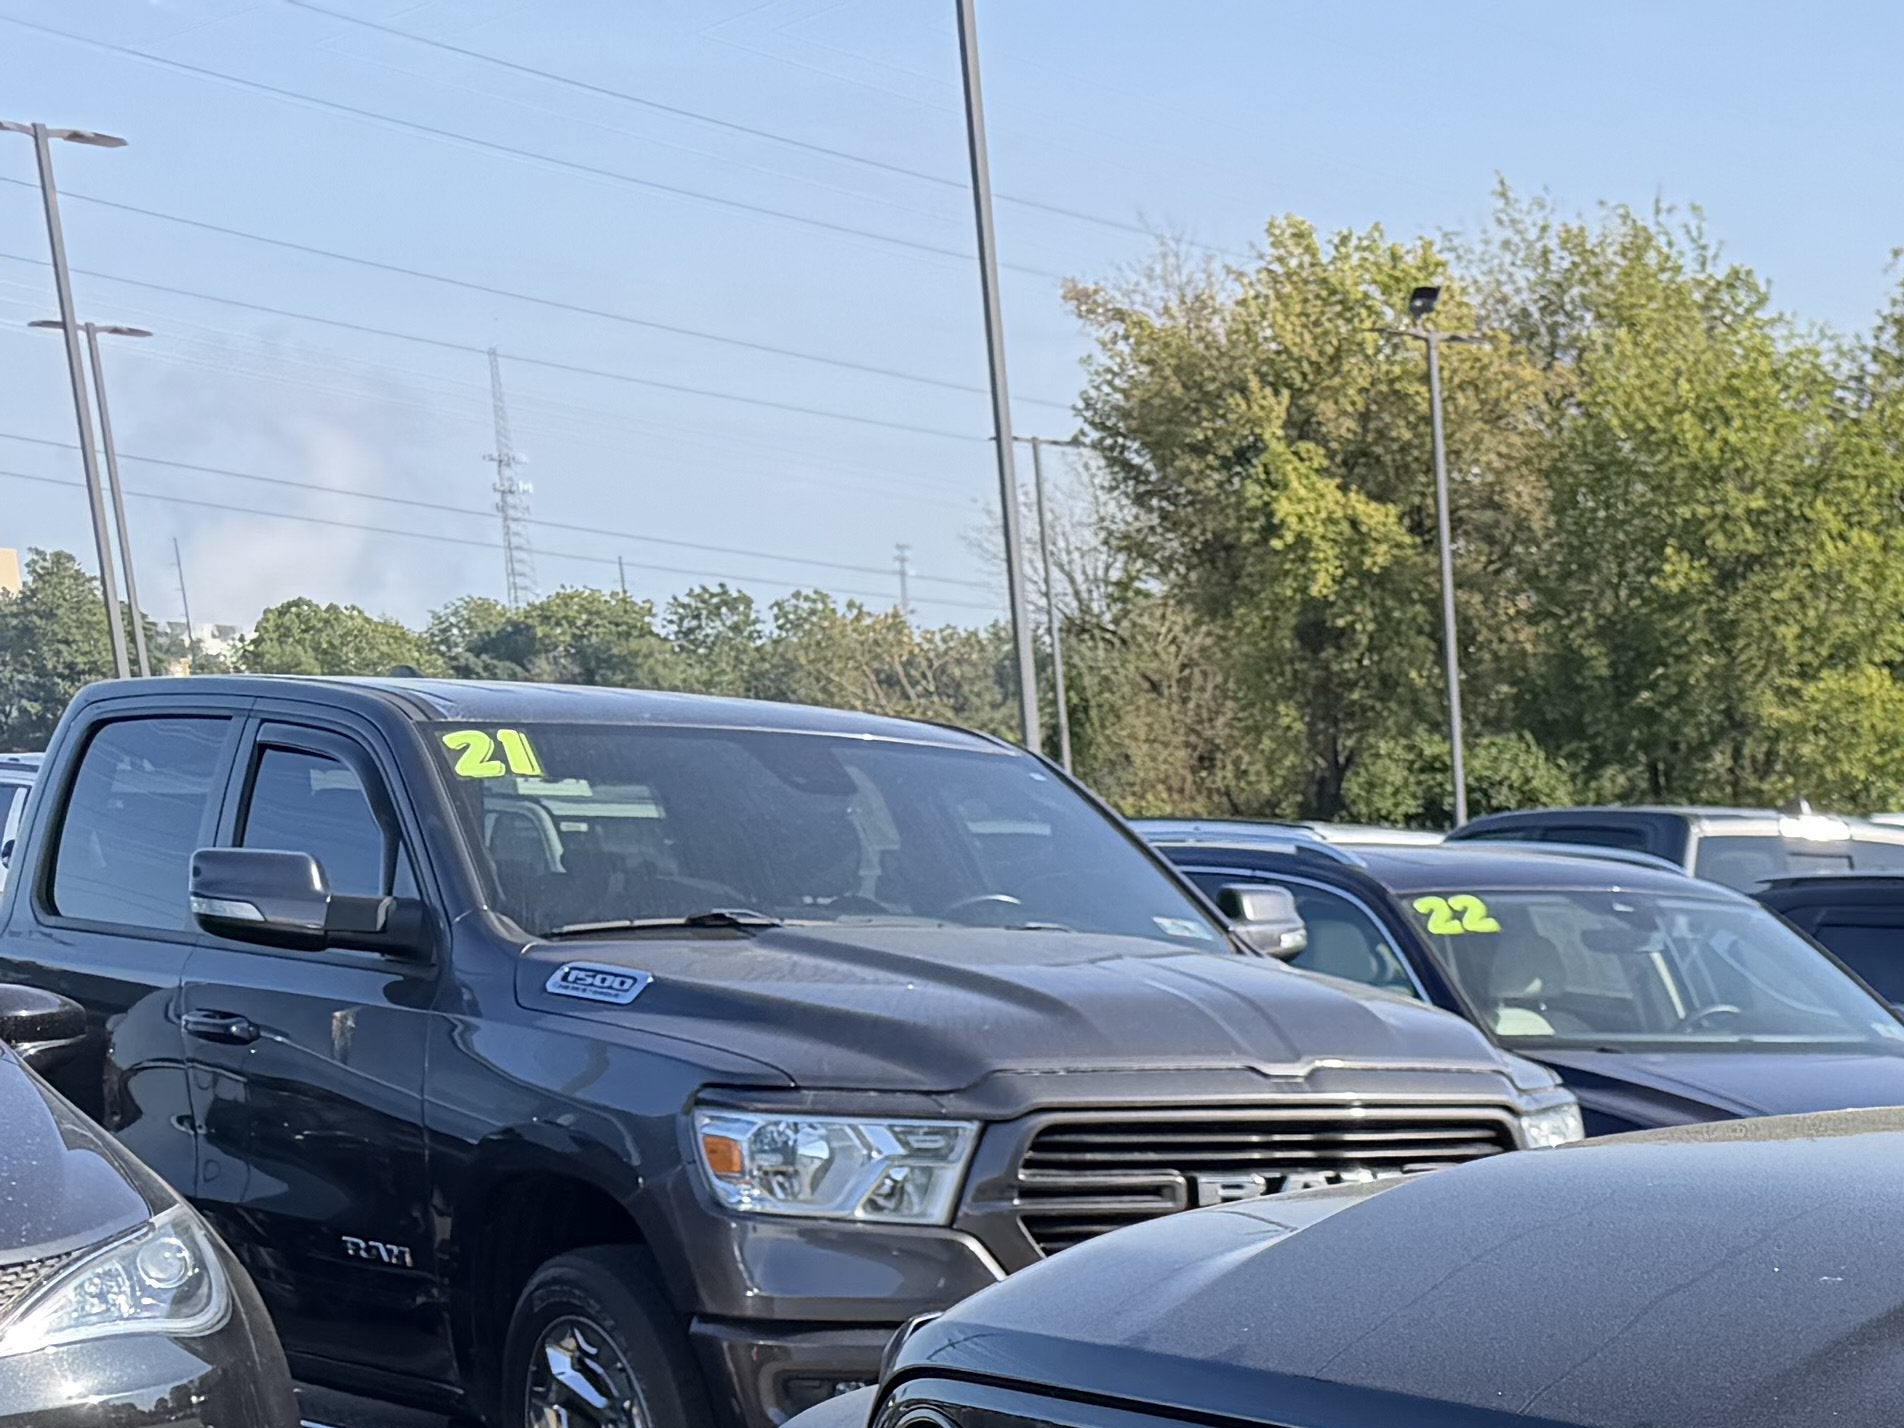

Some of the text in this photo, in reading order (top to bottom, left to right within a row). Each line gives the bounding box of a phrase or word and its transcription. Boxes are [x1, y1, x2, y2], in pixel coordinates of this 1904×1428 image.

[442, 729, 542, 777] 21
[1412, 894, 1502, 935] 22
[567, 969, 634, 991] 1500
[341, 1235, 413, 1268] RAM
